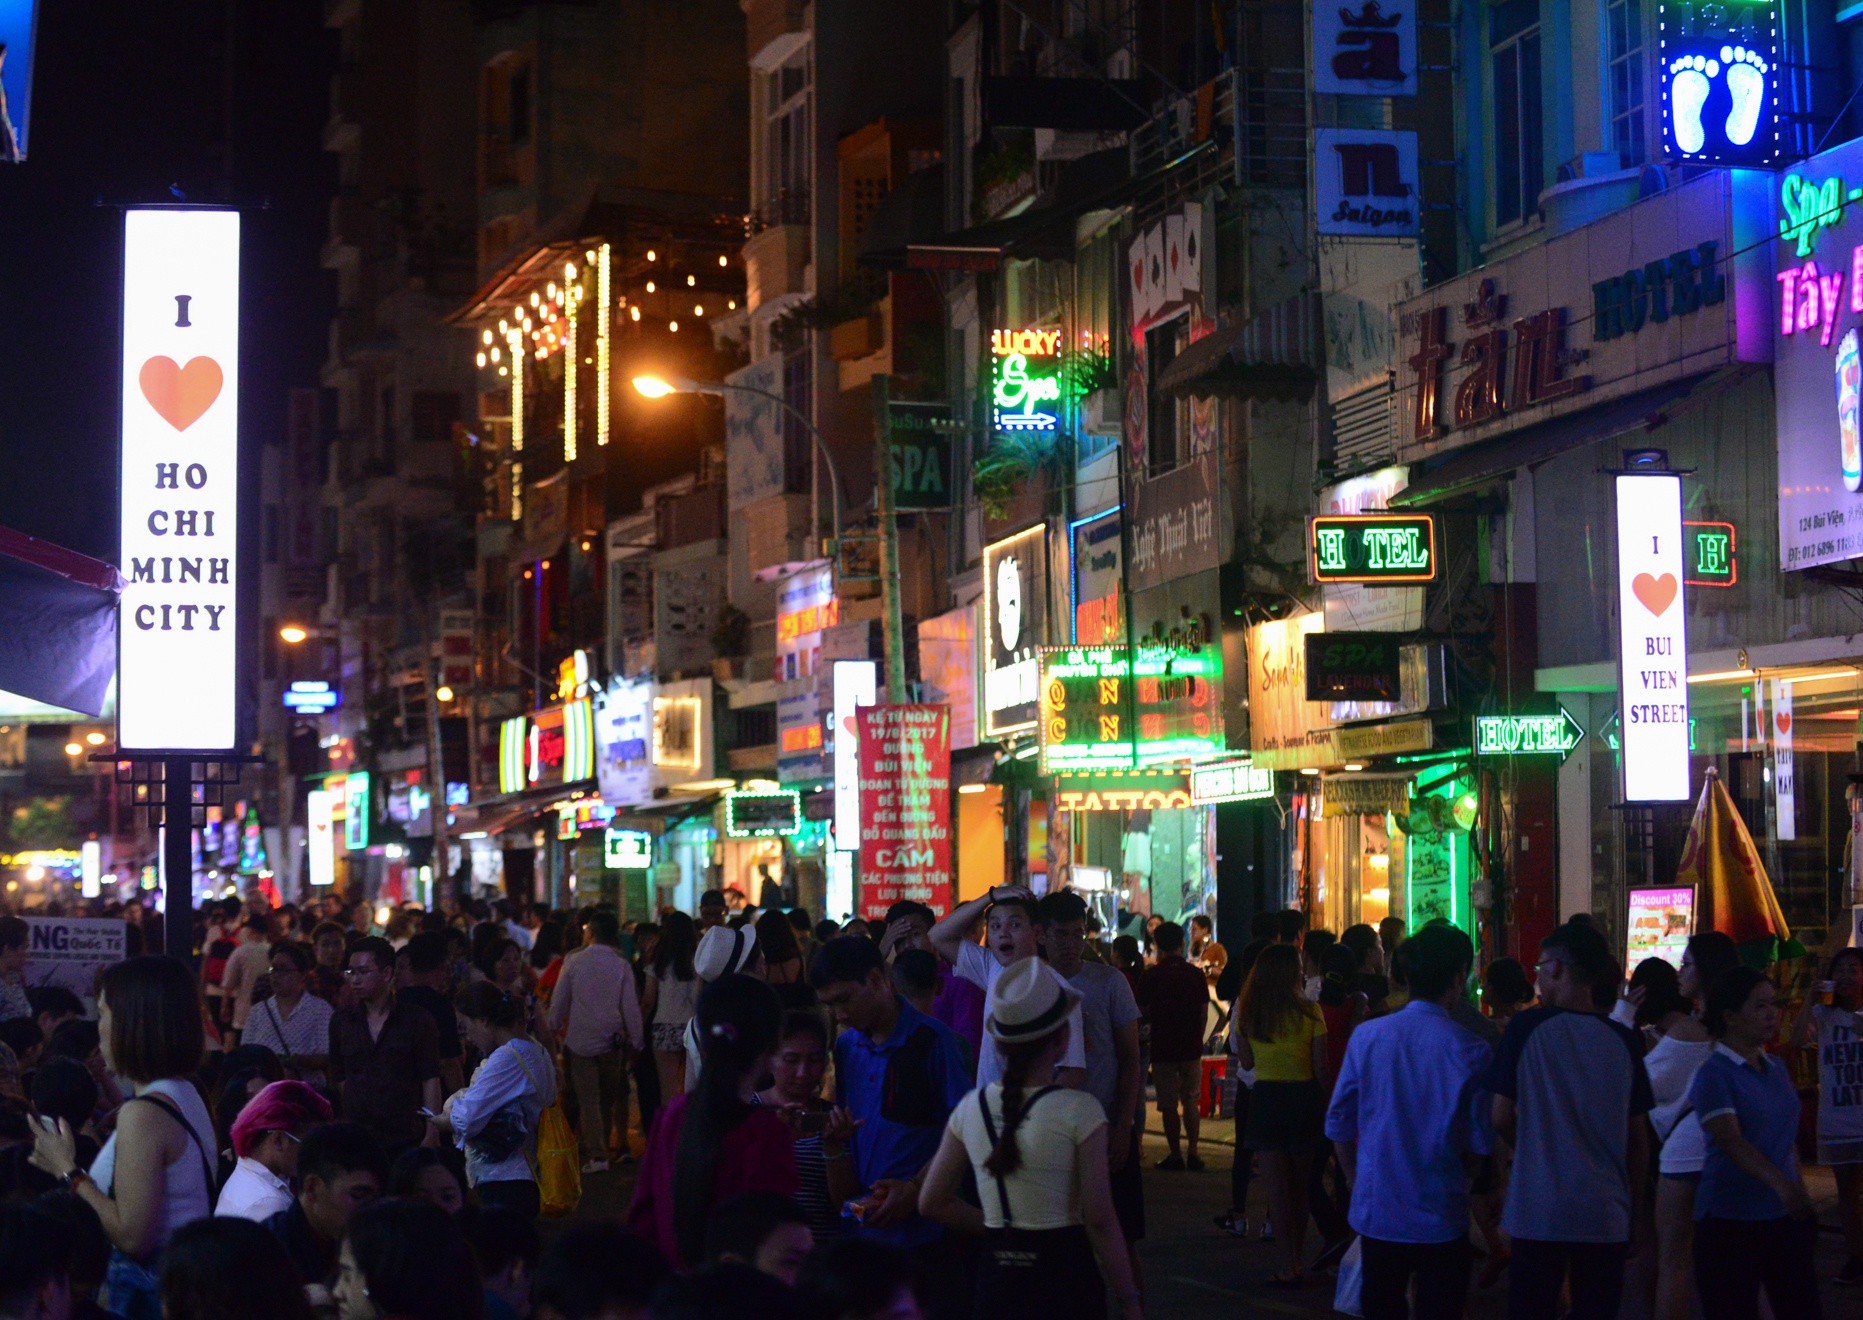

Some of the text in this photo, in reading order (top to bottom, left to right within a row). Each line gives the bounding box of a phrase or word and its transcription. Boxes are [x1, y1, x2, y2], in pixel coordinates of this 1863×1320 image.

[1332, 199, 1412, 227] Saigon
[1780, 174, 1840, 257] Spa
[1592, 240, 1725, 341] HOTEL
[1776, 261, 1843, 346] Tây
[174, 295, 192, 327] I
[995, 331, 1057, 355] LUCKY
[996, 354, 1060, 417] Spa
[155, 463, 207, 489] HO
[147, 510, 215, 537] CHI
[1799, 517, 1812, 532] 124
[1652, 536, 1659, 554] I
[131, 557, 229, 584] MINH
[135, 604, 225, 631] CITY
[1323, 643, 1383, 667] SPA
[1645, 637, 1671, 656] BUI
[1641, 671, 1677, 689] VIEN
[1631, 704, 1685, 723] STREET
[1480, 719, 1573, 750] HOTEL
[1631, 893, 1691, 906] Discount 30%
